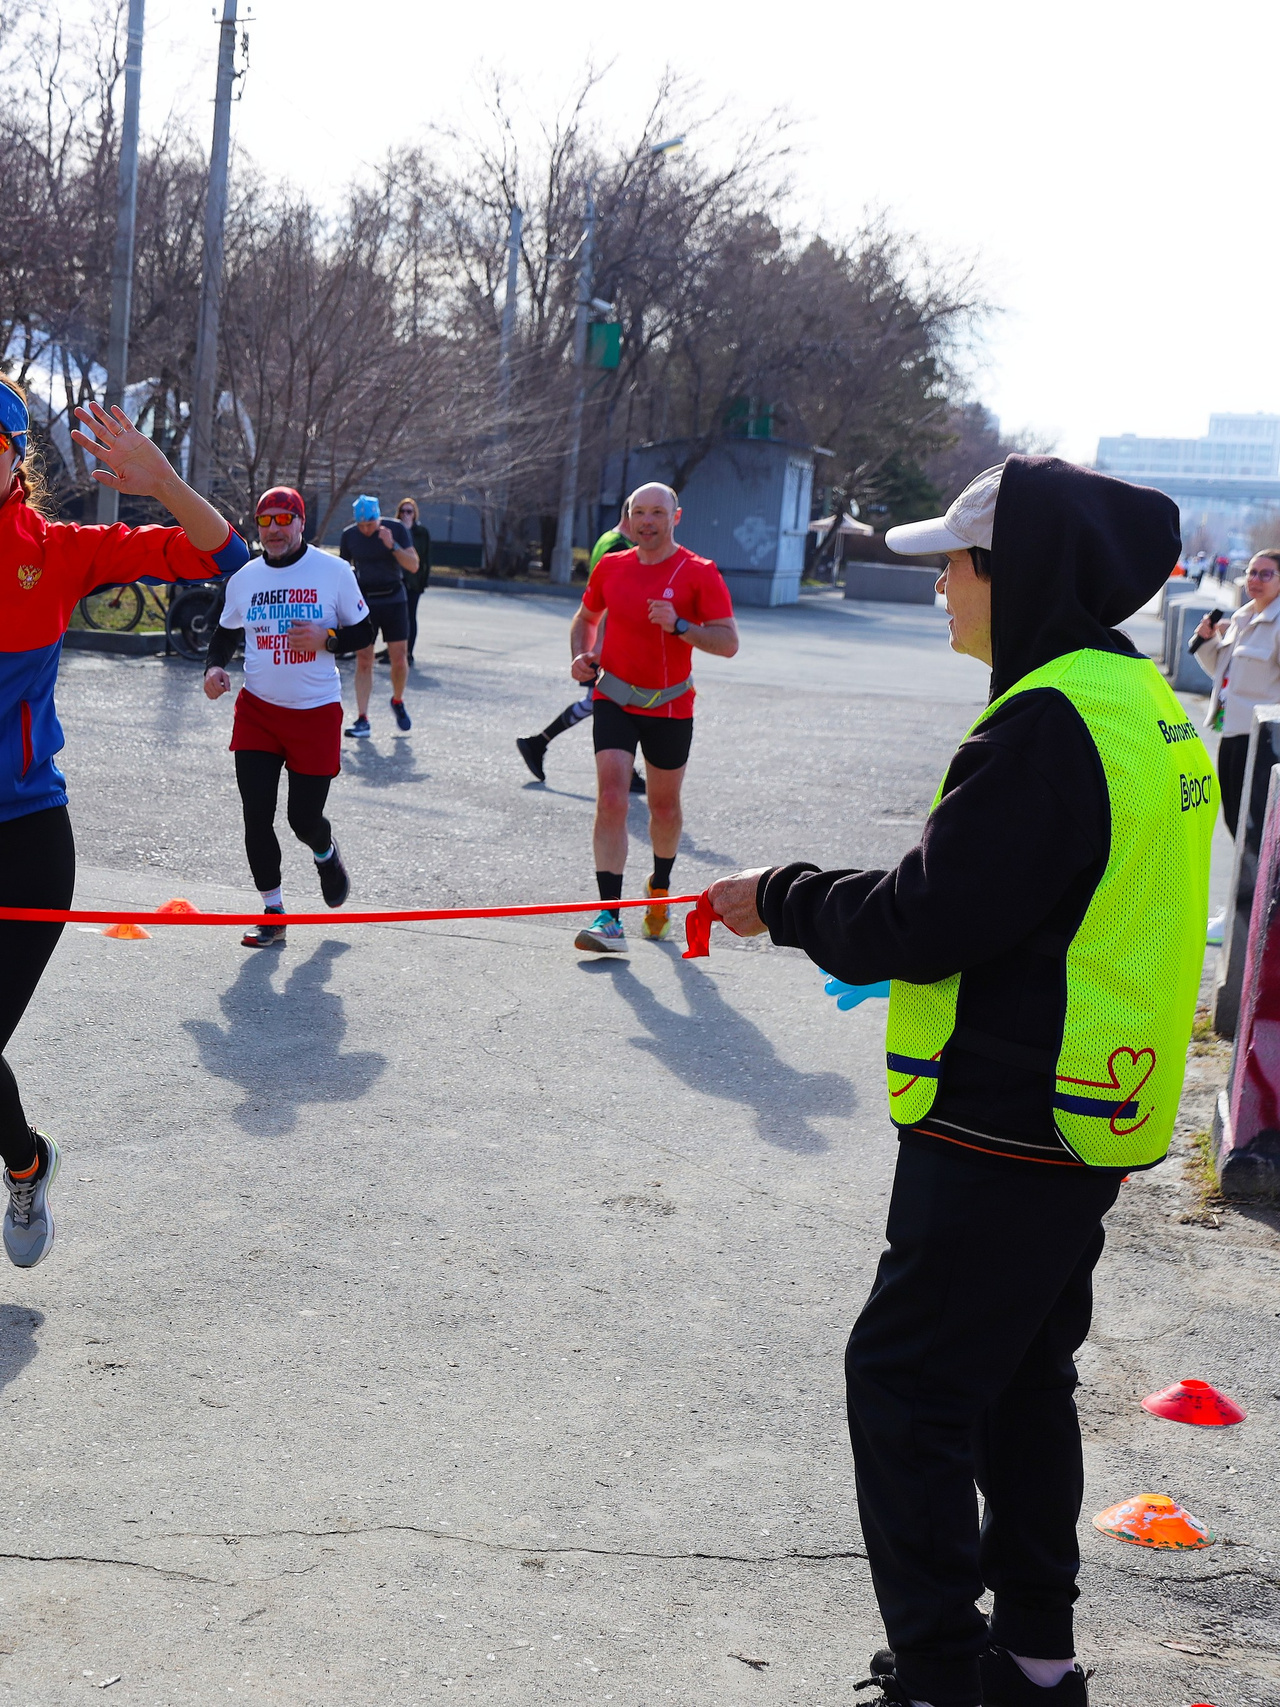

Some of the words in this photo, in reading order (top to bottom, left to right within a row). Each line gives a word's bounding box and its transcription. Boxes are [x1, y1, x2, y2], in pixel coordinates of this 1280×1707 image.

[251, 589, 318, 607] #ЗАБЕГ2025
[246, 606, 267, 622] 45%
[269, 604, 323, 620] ПЛАНЕТЫ
[273, 650, 281, 665] С
